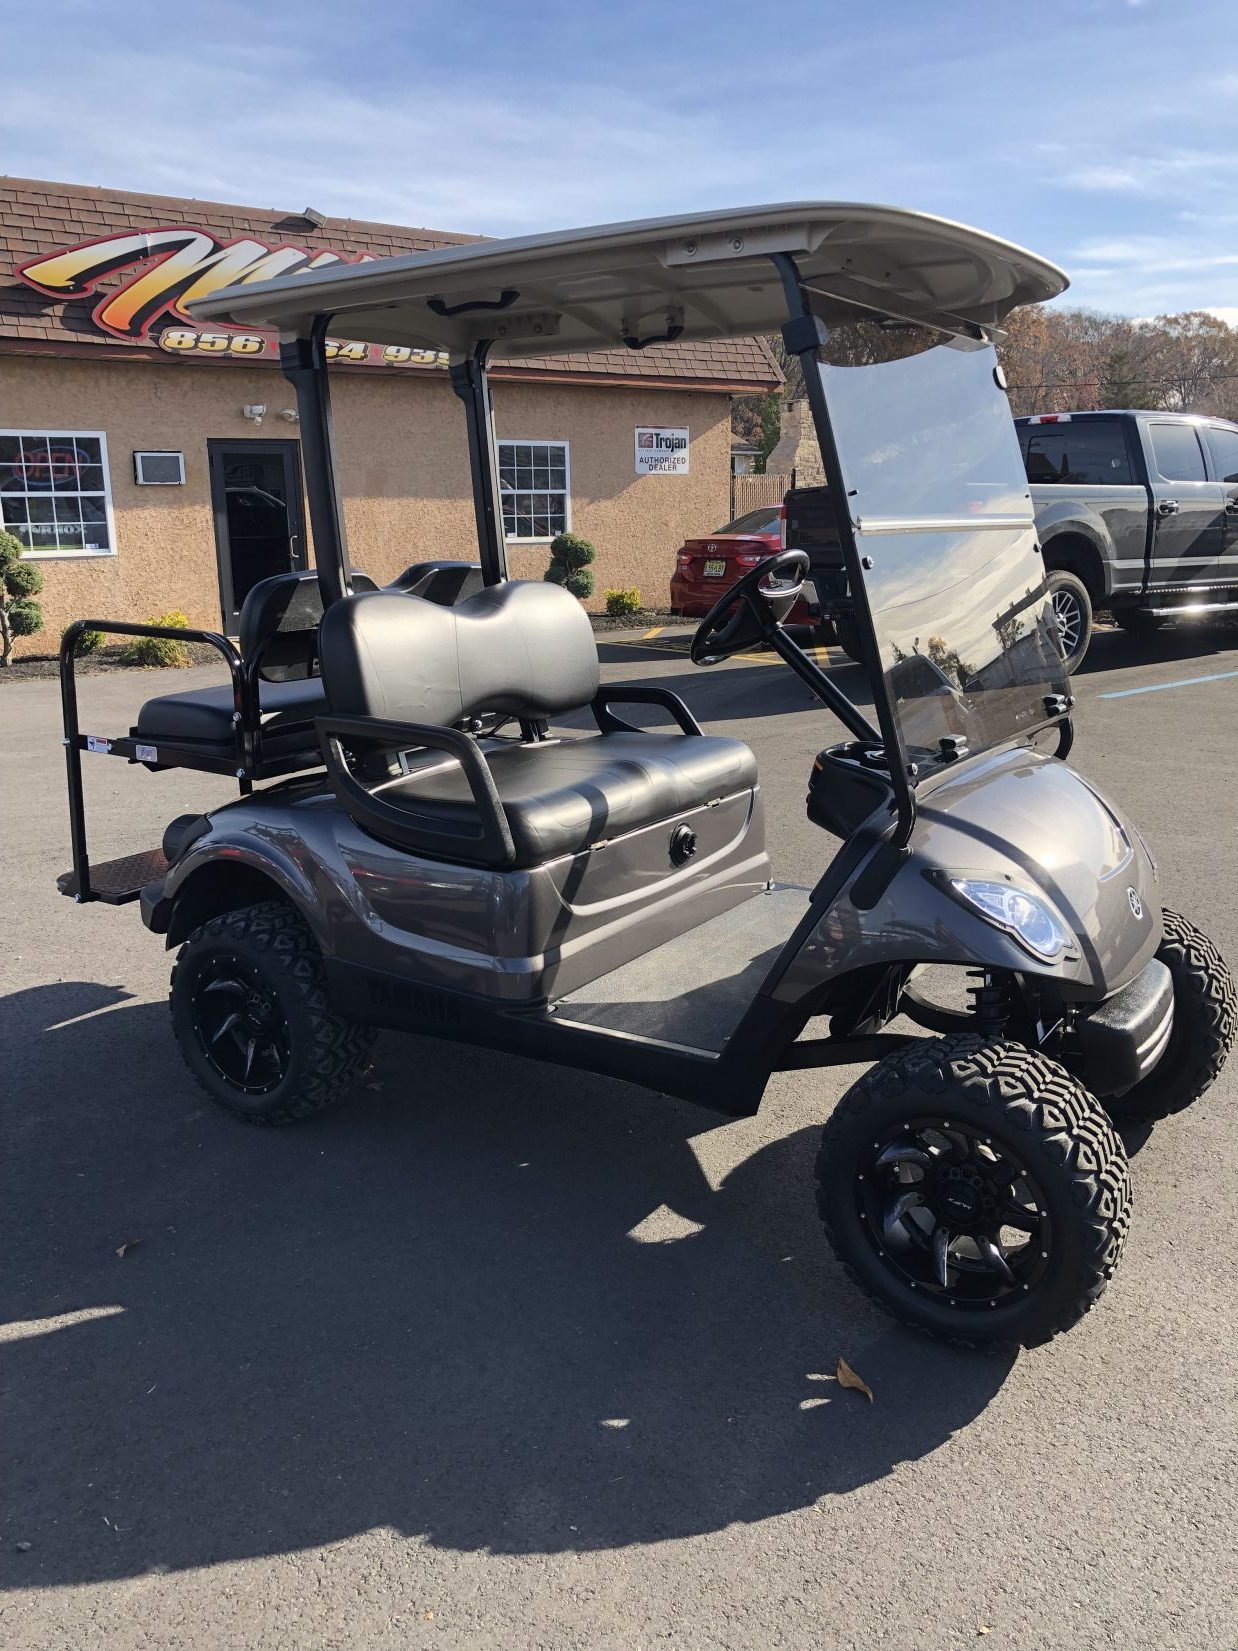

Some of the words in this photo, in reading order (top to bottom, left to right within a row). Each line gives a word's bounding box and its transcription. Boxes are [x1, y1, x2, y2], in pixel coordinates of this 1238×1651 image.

[162, 330, 266, 355] 856
[654, 432, 687, 453] Trojan
[639, 456, 687, 465] AUTHORIZED
[648, 463, 678, 472] DEALER
